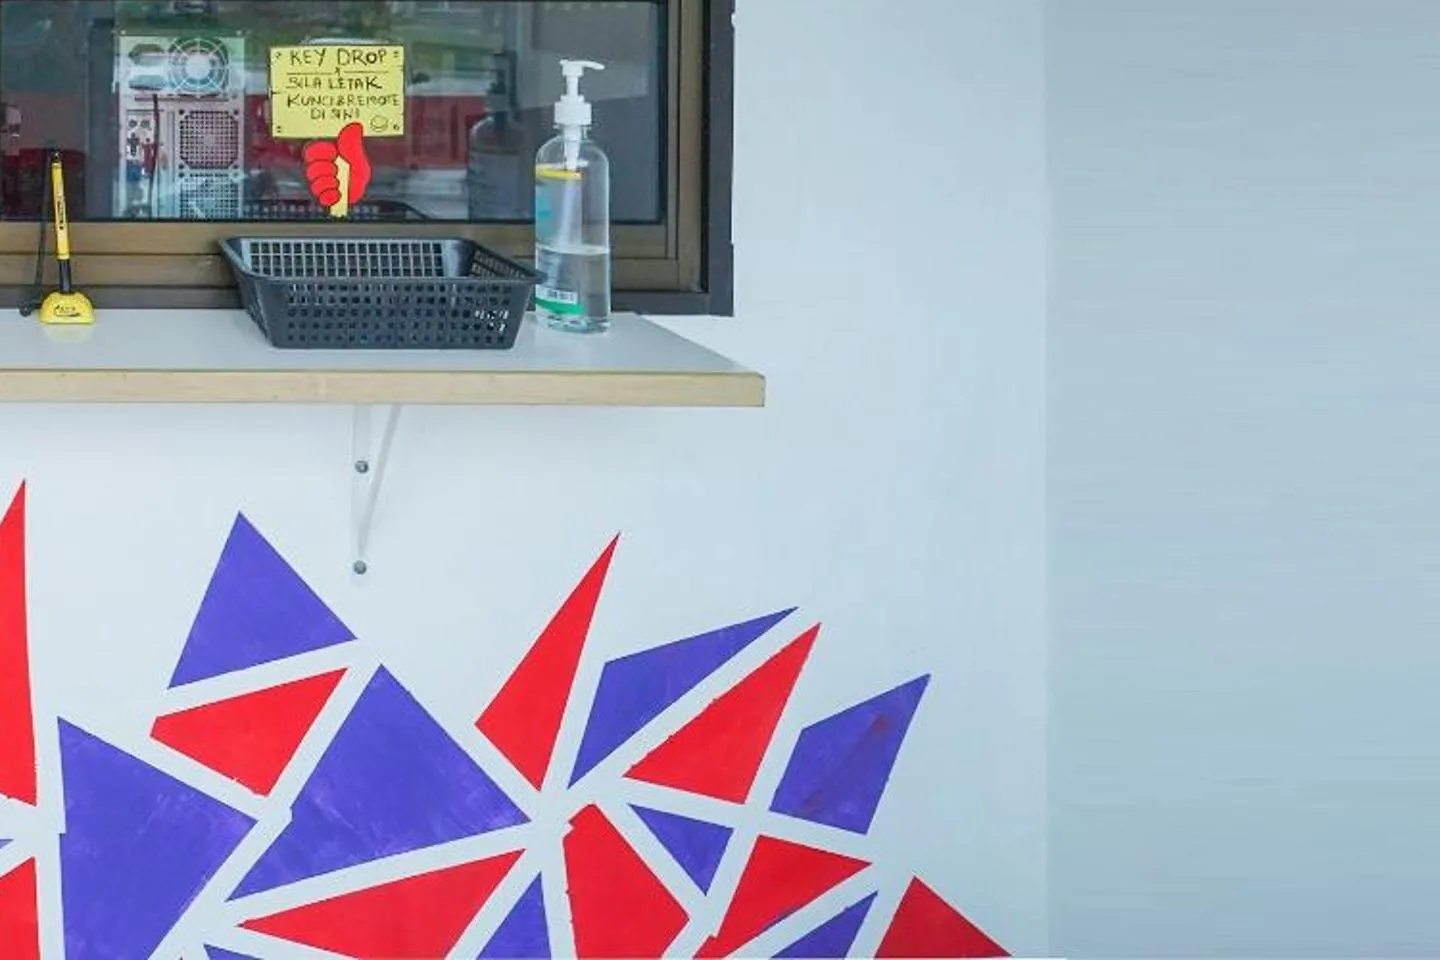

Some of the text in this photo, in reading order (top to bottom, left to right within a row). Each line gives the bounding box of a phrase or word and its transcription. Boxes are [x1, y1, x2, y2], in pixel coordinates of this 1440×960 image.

[290, 48, 387, 67] KEY DROP
[328, 76, 383, 90] LETAK
[310, 108, 326, 120] DI
